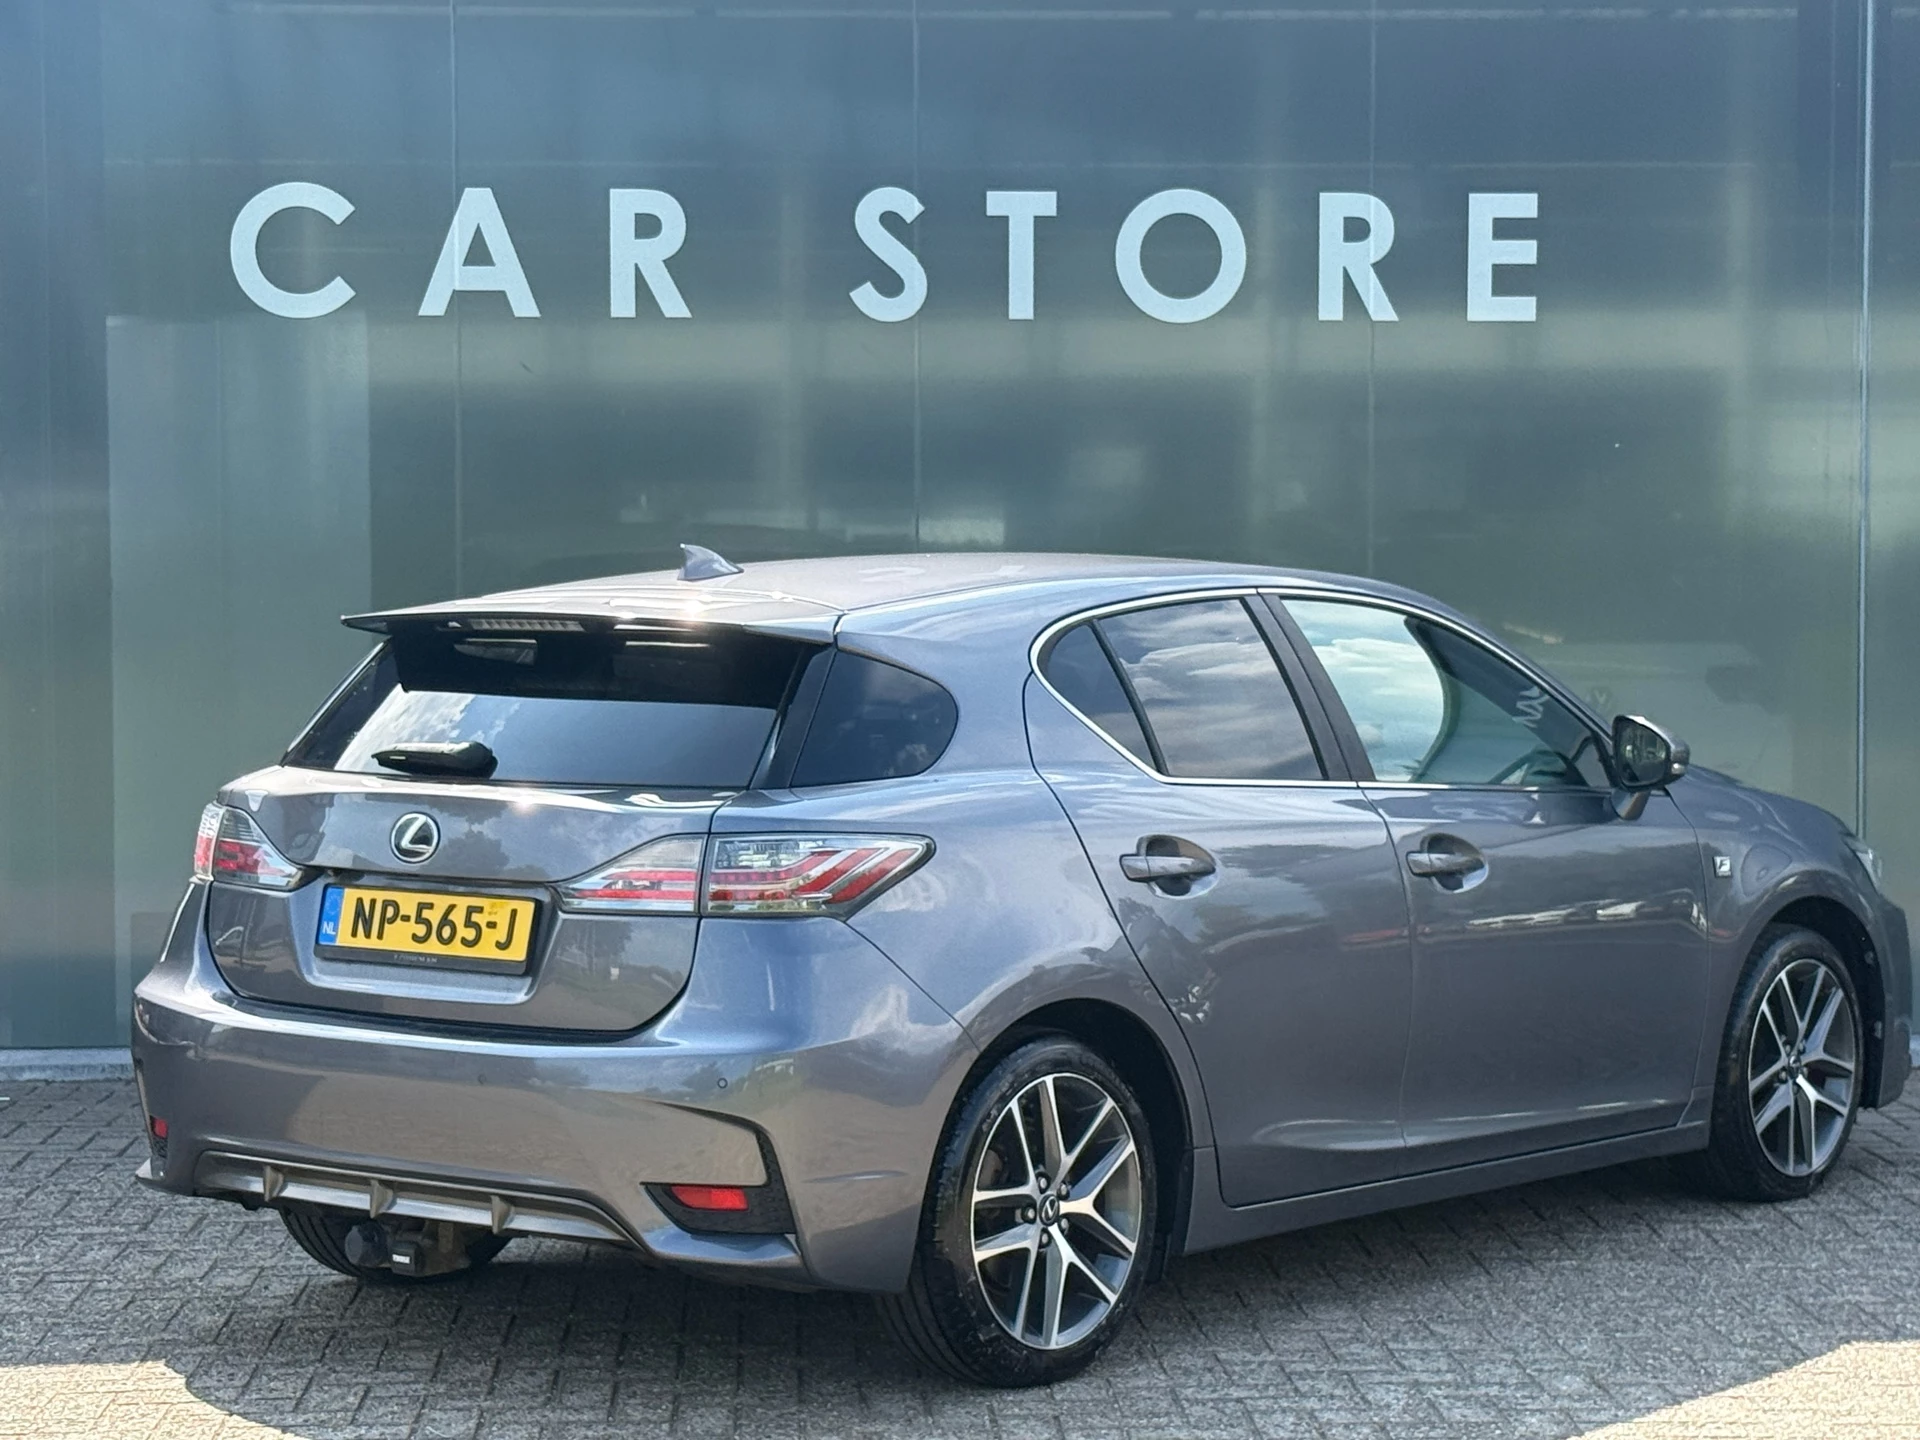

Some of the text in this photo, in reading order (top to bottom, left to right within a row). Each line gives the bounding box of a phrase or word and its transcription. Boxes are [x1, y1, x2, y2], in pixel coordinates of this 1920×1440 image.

[230, 182, 1539, 323] CAR STORE
[322, 921, 336, 935] NL
[351, 896, 518, 951] NP-565-J
